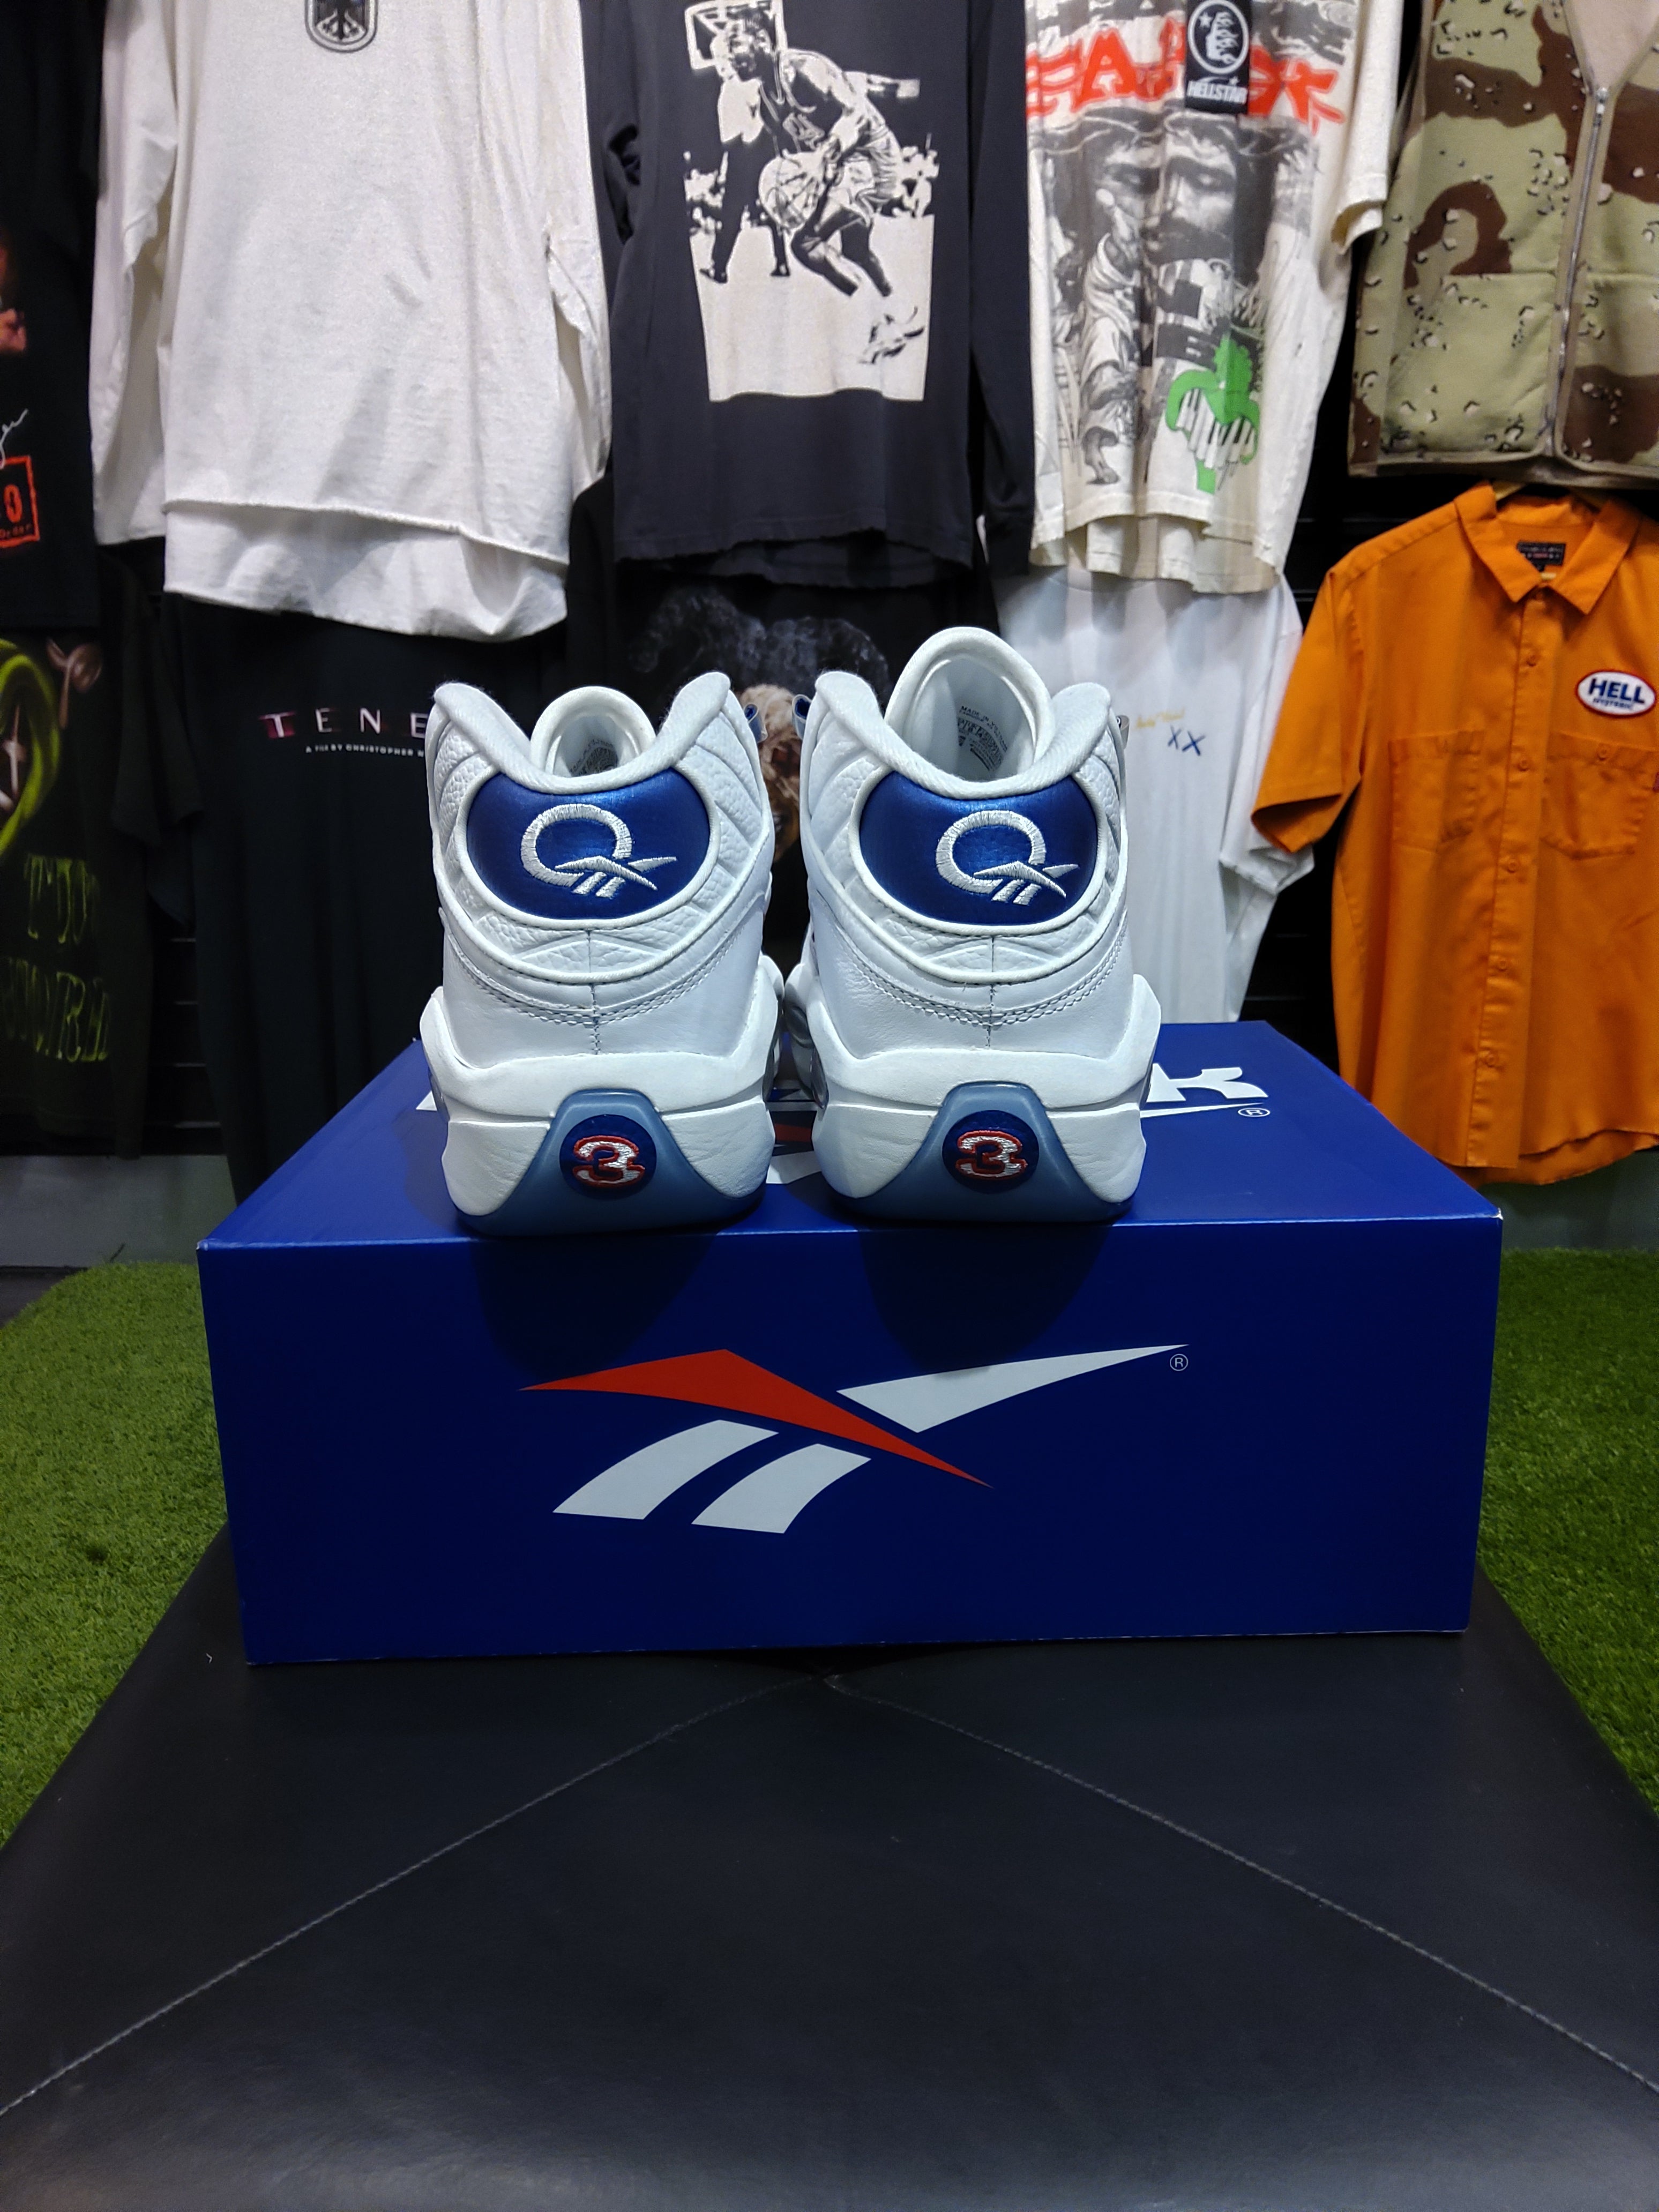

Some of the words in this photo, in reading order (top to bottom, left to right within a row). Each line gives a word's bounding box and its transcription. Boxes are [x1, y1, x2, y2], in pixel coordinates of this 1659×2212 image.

[1186, 80, 1248, 104] HELLSTAR
[1588, 678, 1645, 704] HELL
[345, 743, 414, 757] CHRISTOPHER
[571, 1133, 648, 1189] 3
[954, 1129, 1029, 1181] 3
